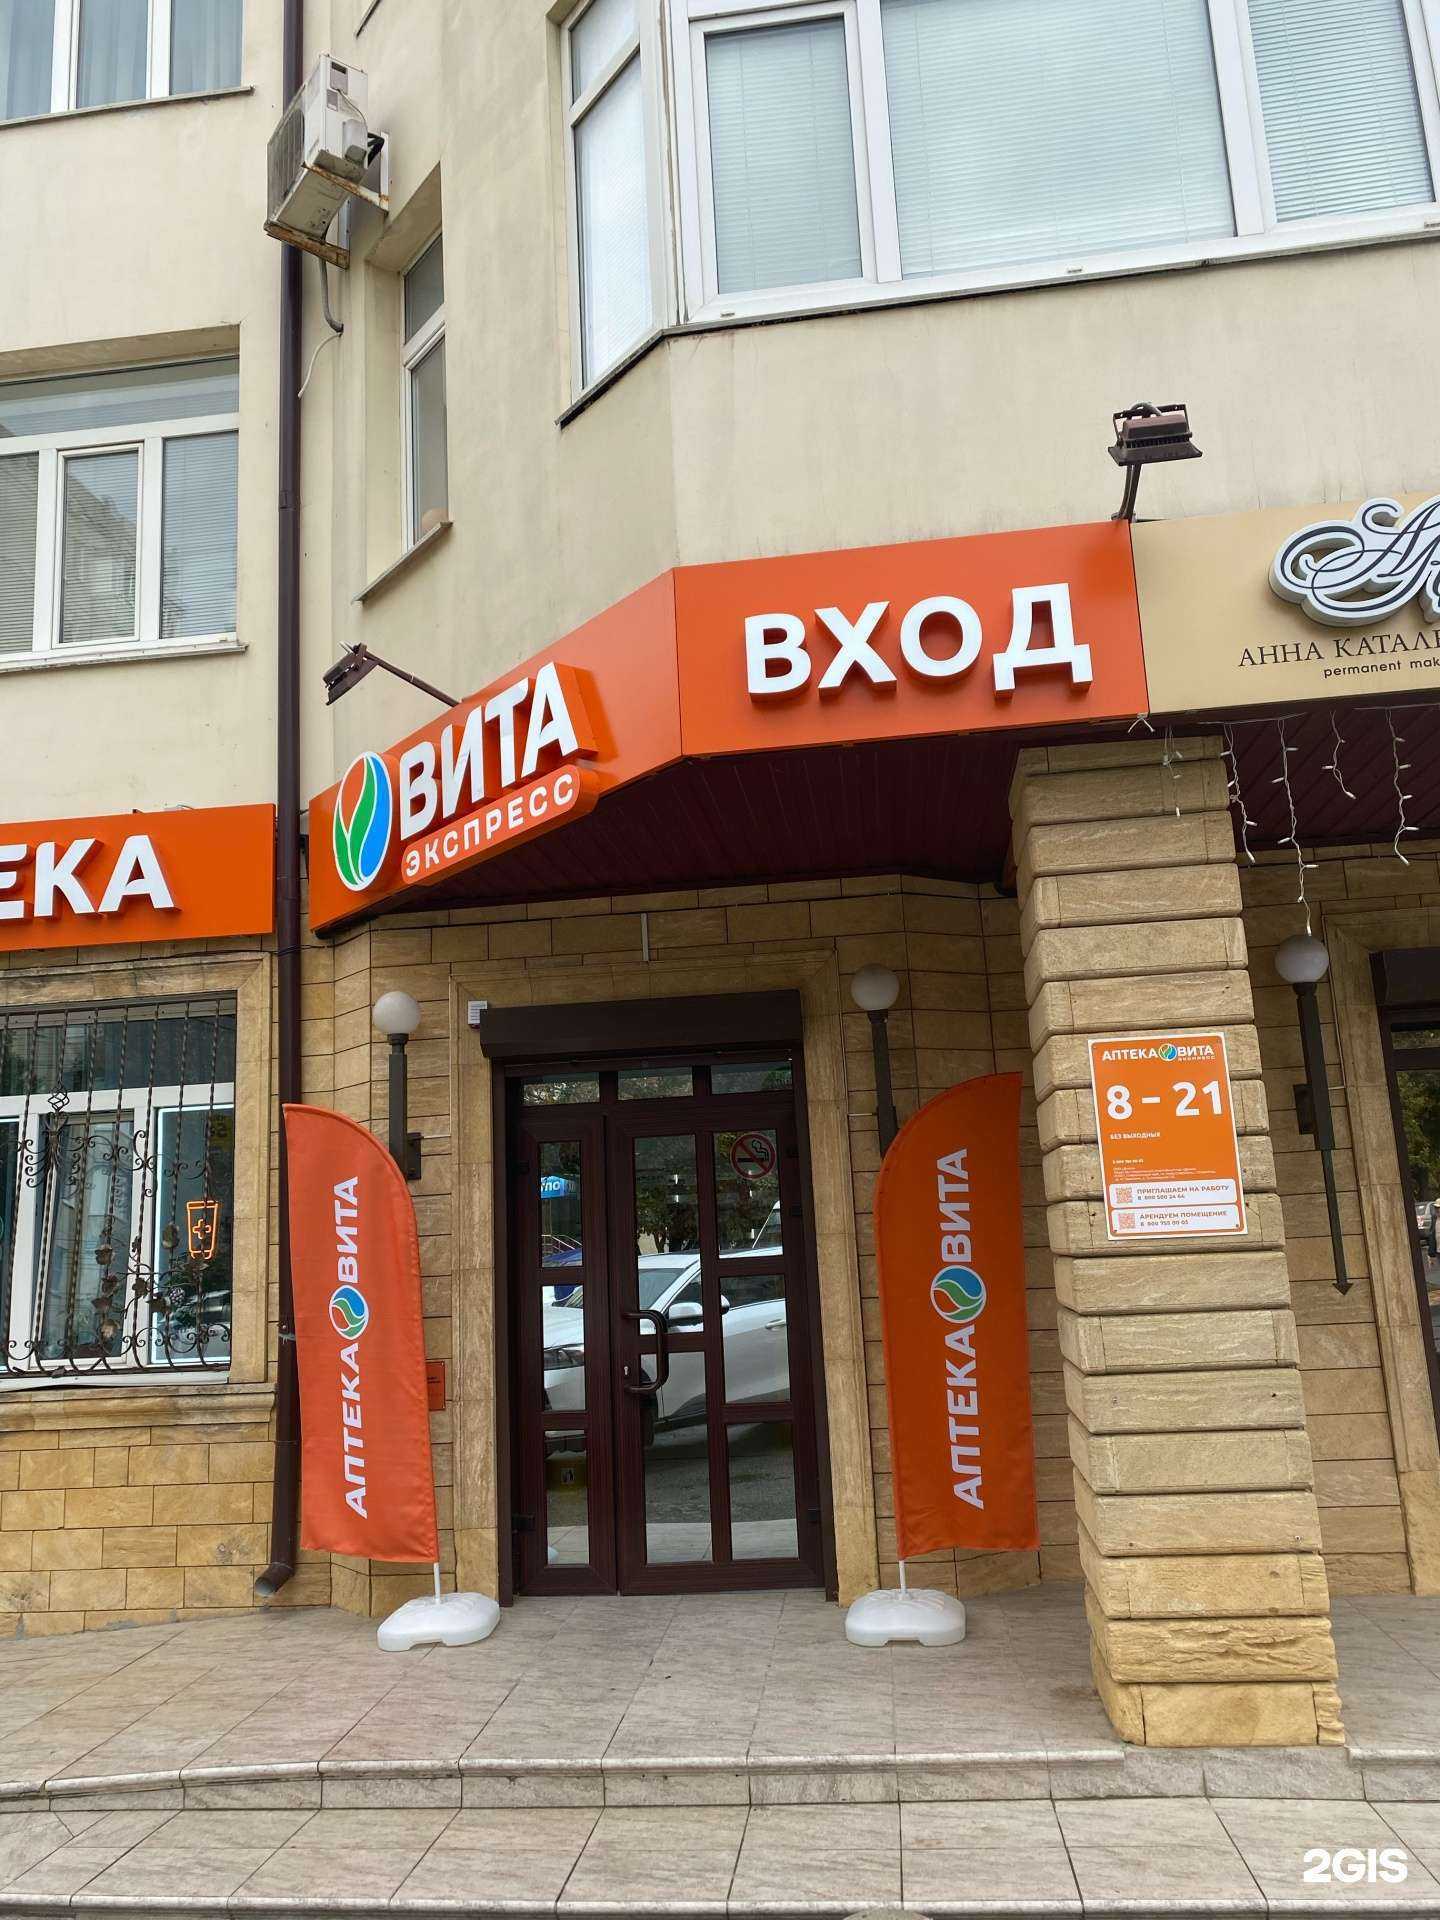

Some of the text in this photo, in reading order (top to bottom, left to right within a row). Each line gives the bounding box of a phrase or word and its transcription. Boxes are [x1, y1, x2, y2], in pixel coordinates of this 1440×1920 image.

[744, 582, 1094, 697] ВХОД
[1238, 641, 1324, 667] АННА
[1323, 659, 1402, 679] permanent
[399, 661, 579, 841] ВИТА
[405, 773, 573, 878] ЭКСПРЕСС
[1102, 1044, 1215, 1062] АПТЕКА ВИТА
[1106, 1084, 1133, 1120] 8
[1171, 1080, 1223, 1117] 21
[1137, 1186, 1188, 1195] ПРИГЛАШАЕМ
[1180, 1210, 1227, 1218] ПОМЕЩЕНИЕ
[333, 1175, 368, 1520] АПТЕКА ВИТА
[936, 1148, 985, 1510] АПТЕКА ВИТА
